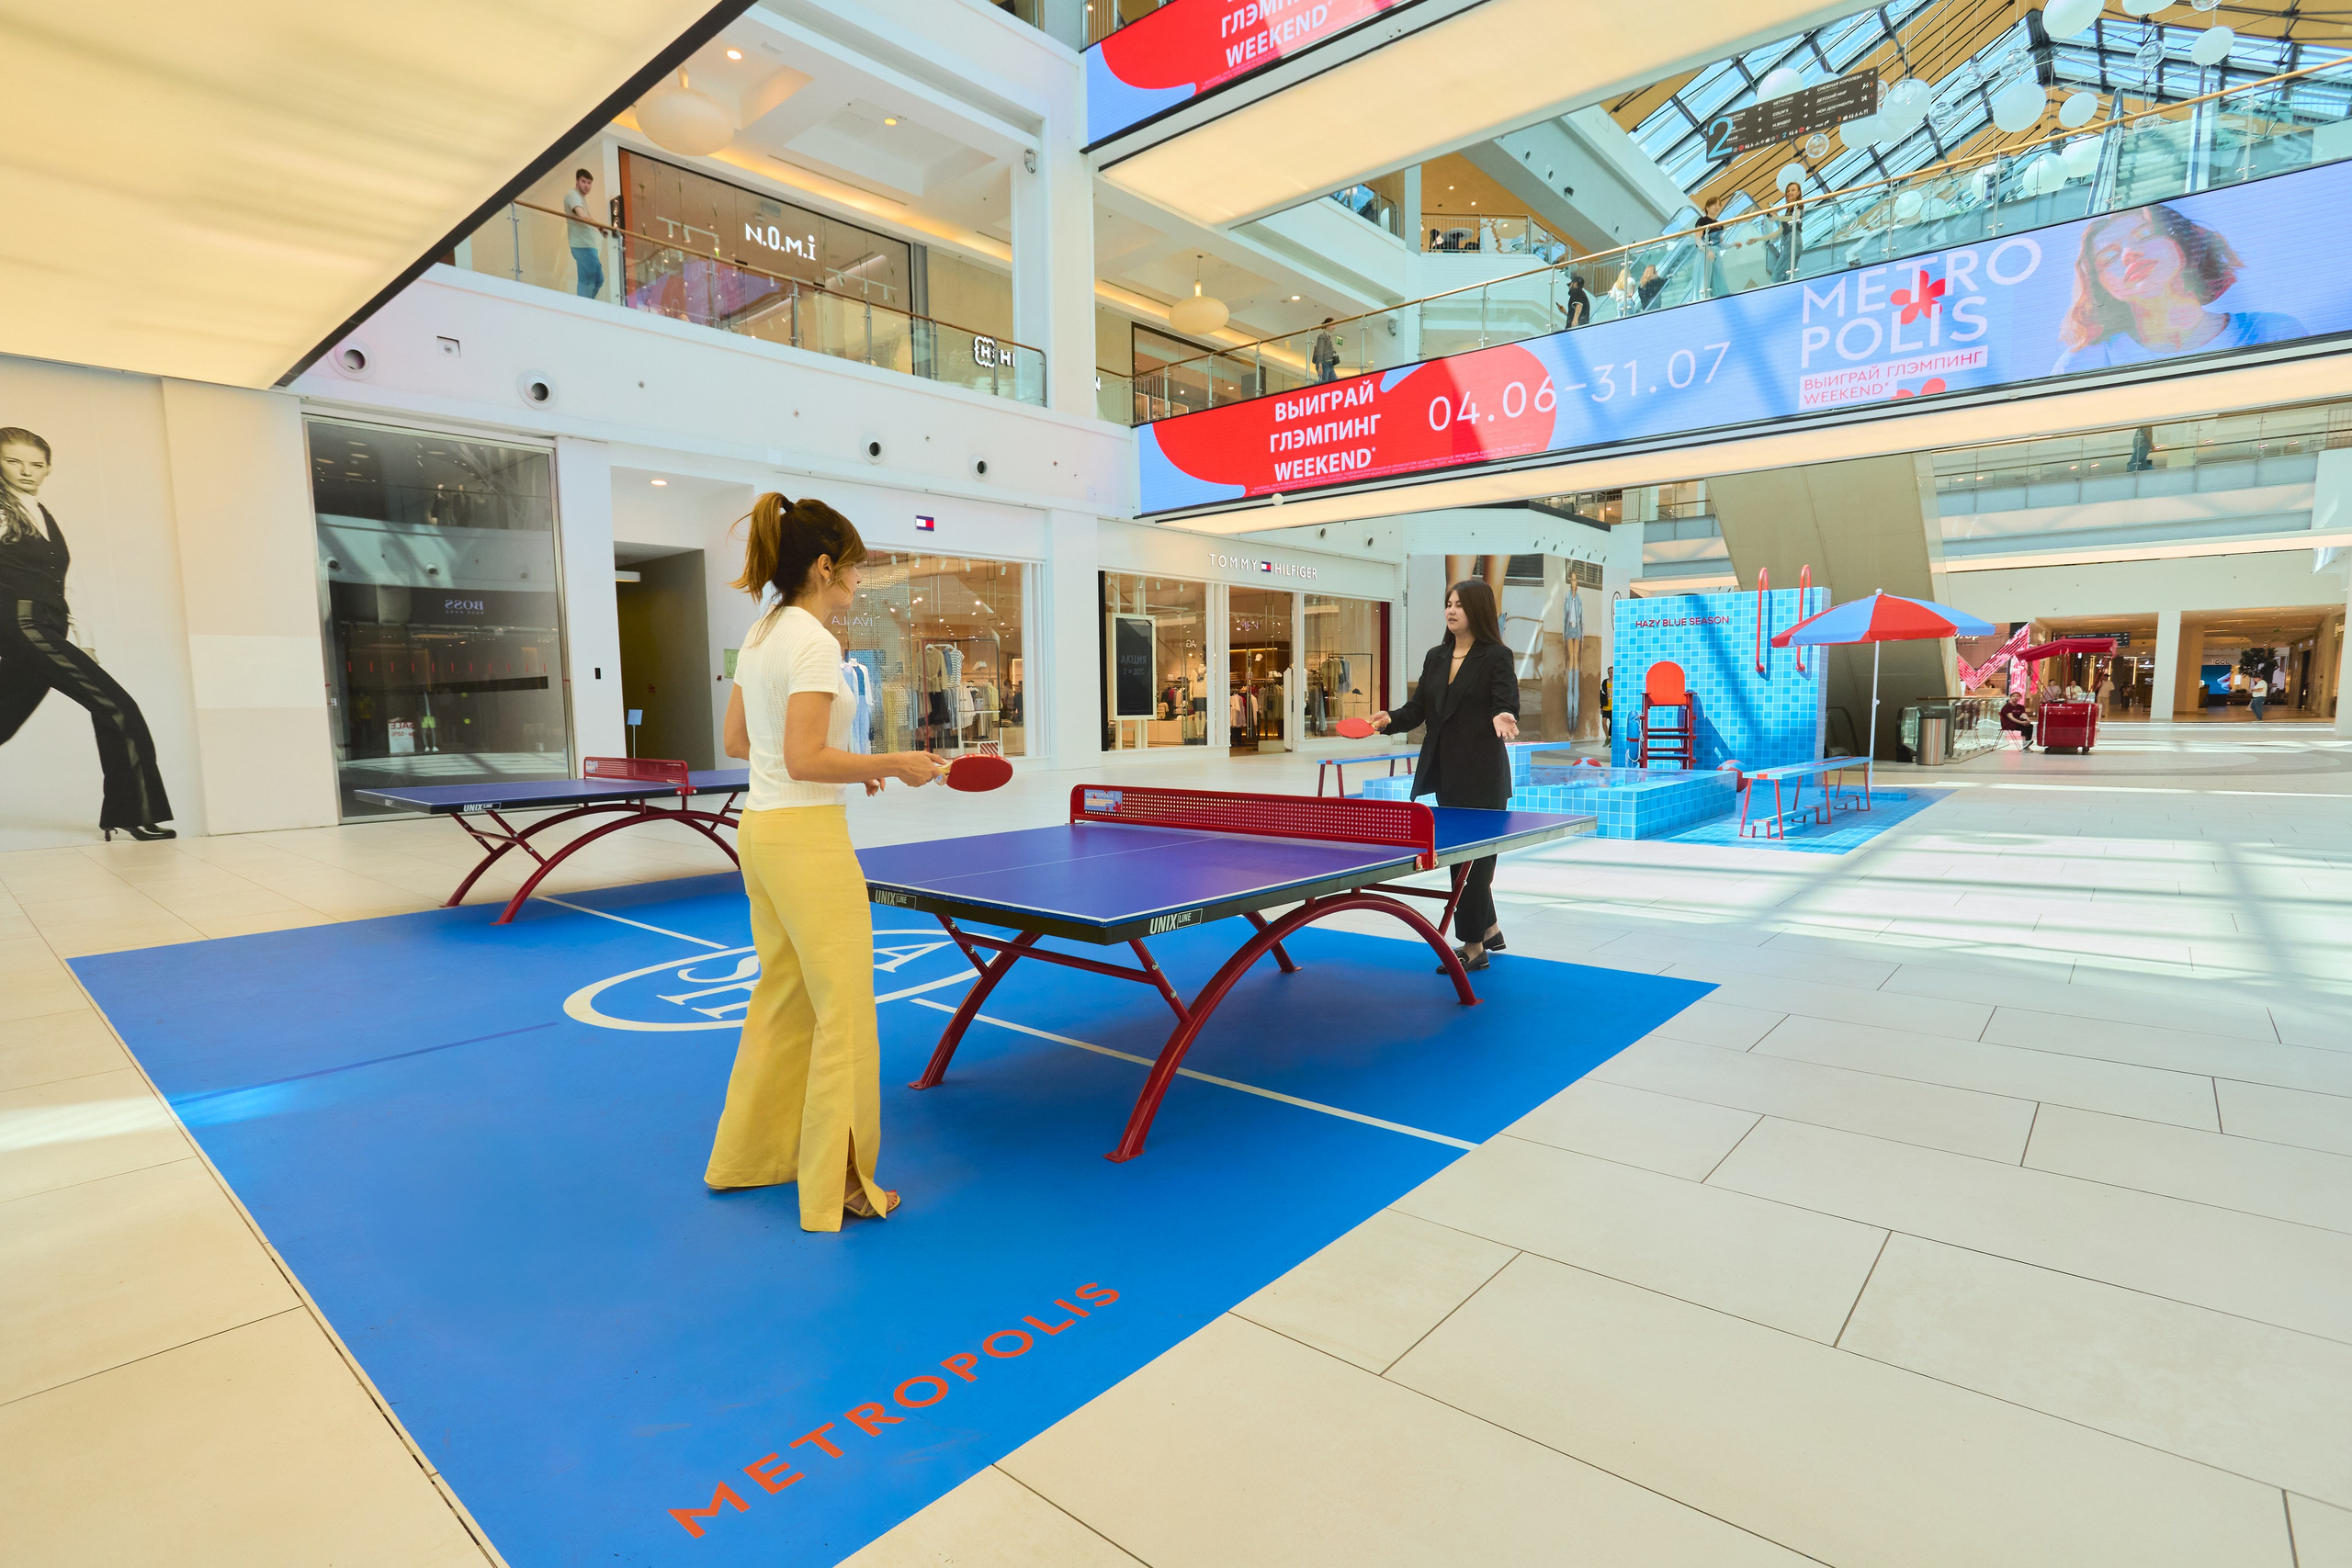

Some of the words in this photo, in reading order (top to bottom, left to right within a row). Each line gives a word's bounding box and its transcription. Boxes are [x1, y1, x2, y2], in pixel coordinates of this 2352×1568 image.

[1707, 116, 1734, 159] 2
[1803, 237, 2042, 325] METRO
[1802, 296, 1988, 369] POLIS
[1804, 364, 1880, 391] ВЫИГРАЙ
[1886, 350, 1984, 378] ГЛЭМПИНГ
[1274, 379, 1374, 423] ВЫИГРАЙ
[1270, 413, 1382, 453] ГЛЭМПИНГ
[1209, 553, 1258, 571] TOMMY
[1274, 562, 1318, 580] HILFIGER
[1635, 619, 1661, 628] HAZY
[1662, 617, 1687, 626] BLUE
[1689, 615, 1730, 626] SEASON
[1120, 654, 1148, 665] АКЦИЯ
[463, 803, 483, 812] UNIX
[875, 889, 896, 907] UNIX
[897, 895, 908, 905] LINE
[1149, 913, 1178, 935] UNIX
[1179, 912, 1192, 923] LINE
[667, 1282, 1120, 1539] METROPOLIS
